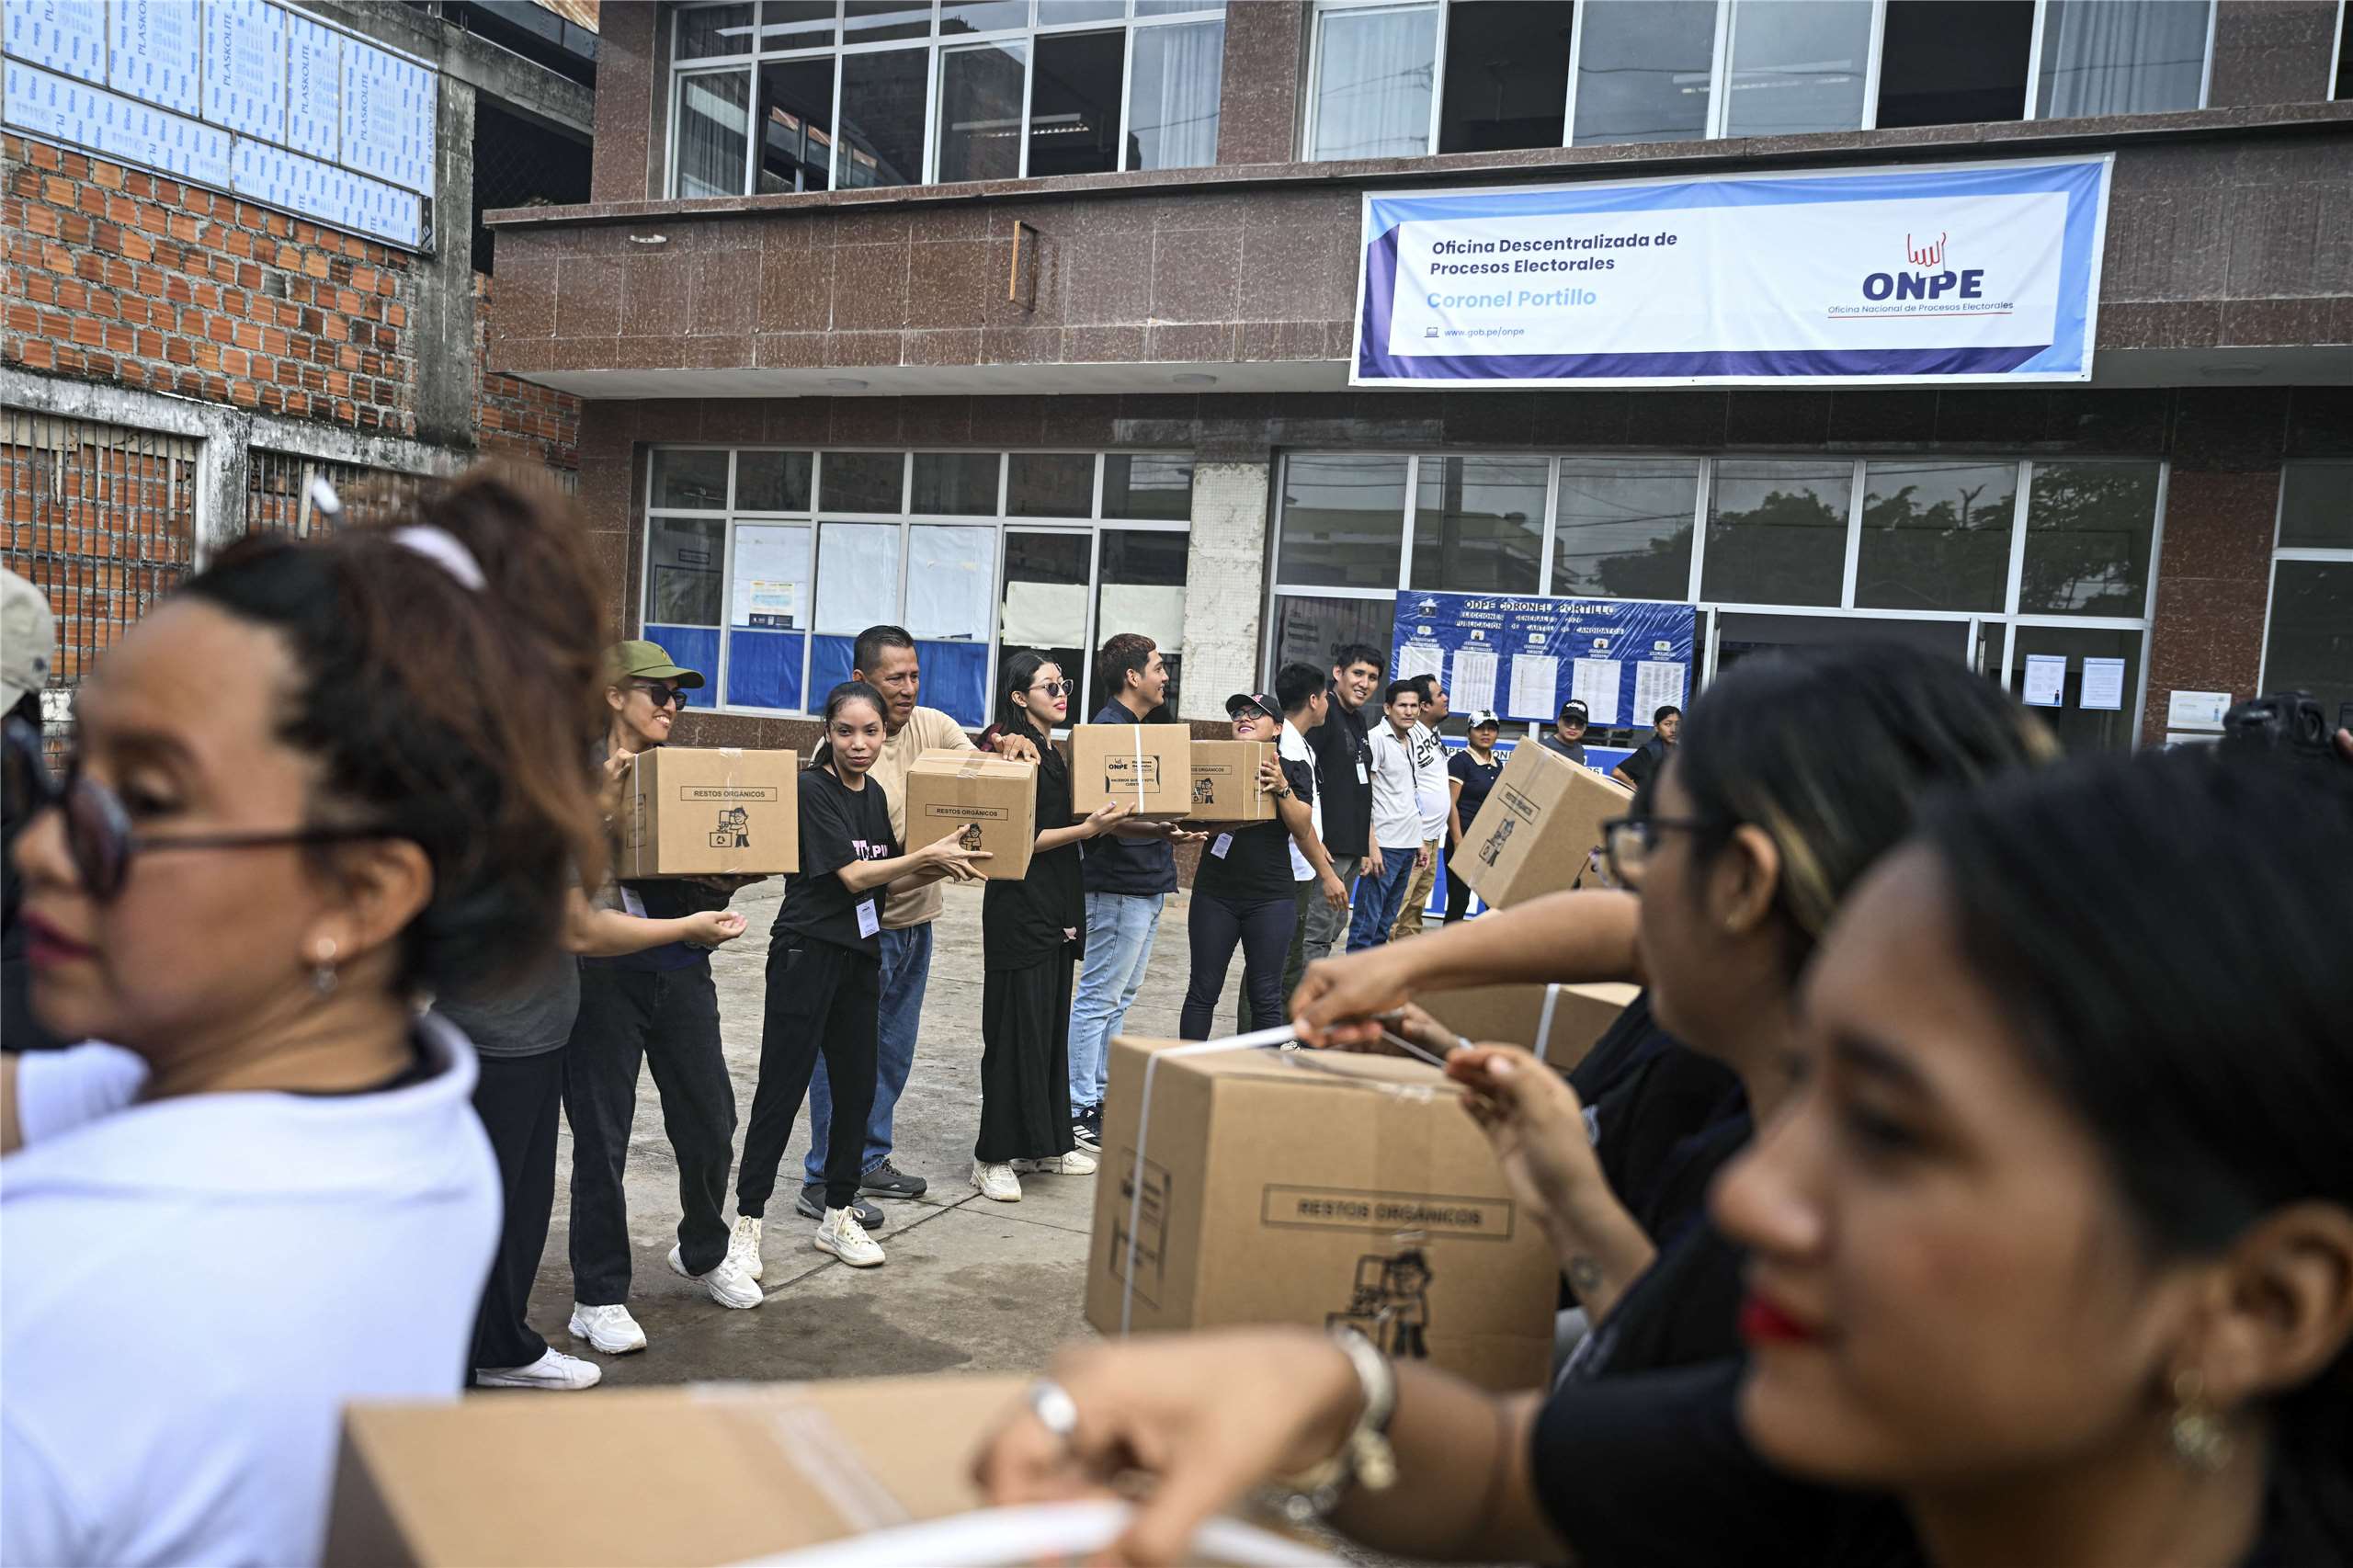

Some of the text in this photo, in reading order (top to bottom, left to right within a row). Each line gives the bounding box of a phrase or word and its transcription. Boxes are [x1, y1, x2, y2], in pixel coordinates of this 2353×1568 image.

[223, 13, 233, 86] PLASKOLITE
[301, 44, 310, 114] PLASKOLITE
[360, 73, 369, 142] PLASKOLITE
[1432, 232, 1677, 255] Oficina Descentralizada de
[1430, 256, 1615, 275] Procesos Electorales
[1862, 269, 1984, 301] ONPE
[1427, 289, 1597, 309] Coronel Portillo
[1828, 301, 2013, 313] Oficina Nacional de Procesos Electorales
[1444, 327, 1525, 338] www.gob.pe/onpe
[1465, 600, 1617, 615] ODPE CORONEL PORTILLO
[961, 809, 998, 817] ORGÁNICOS
[1298, 1199, 1370, 1219] RESTOS
